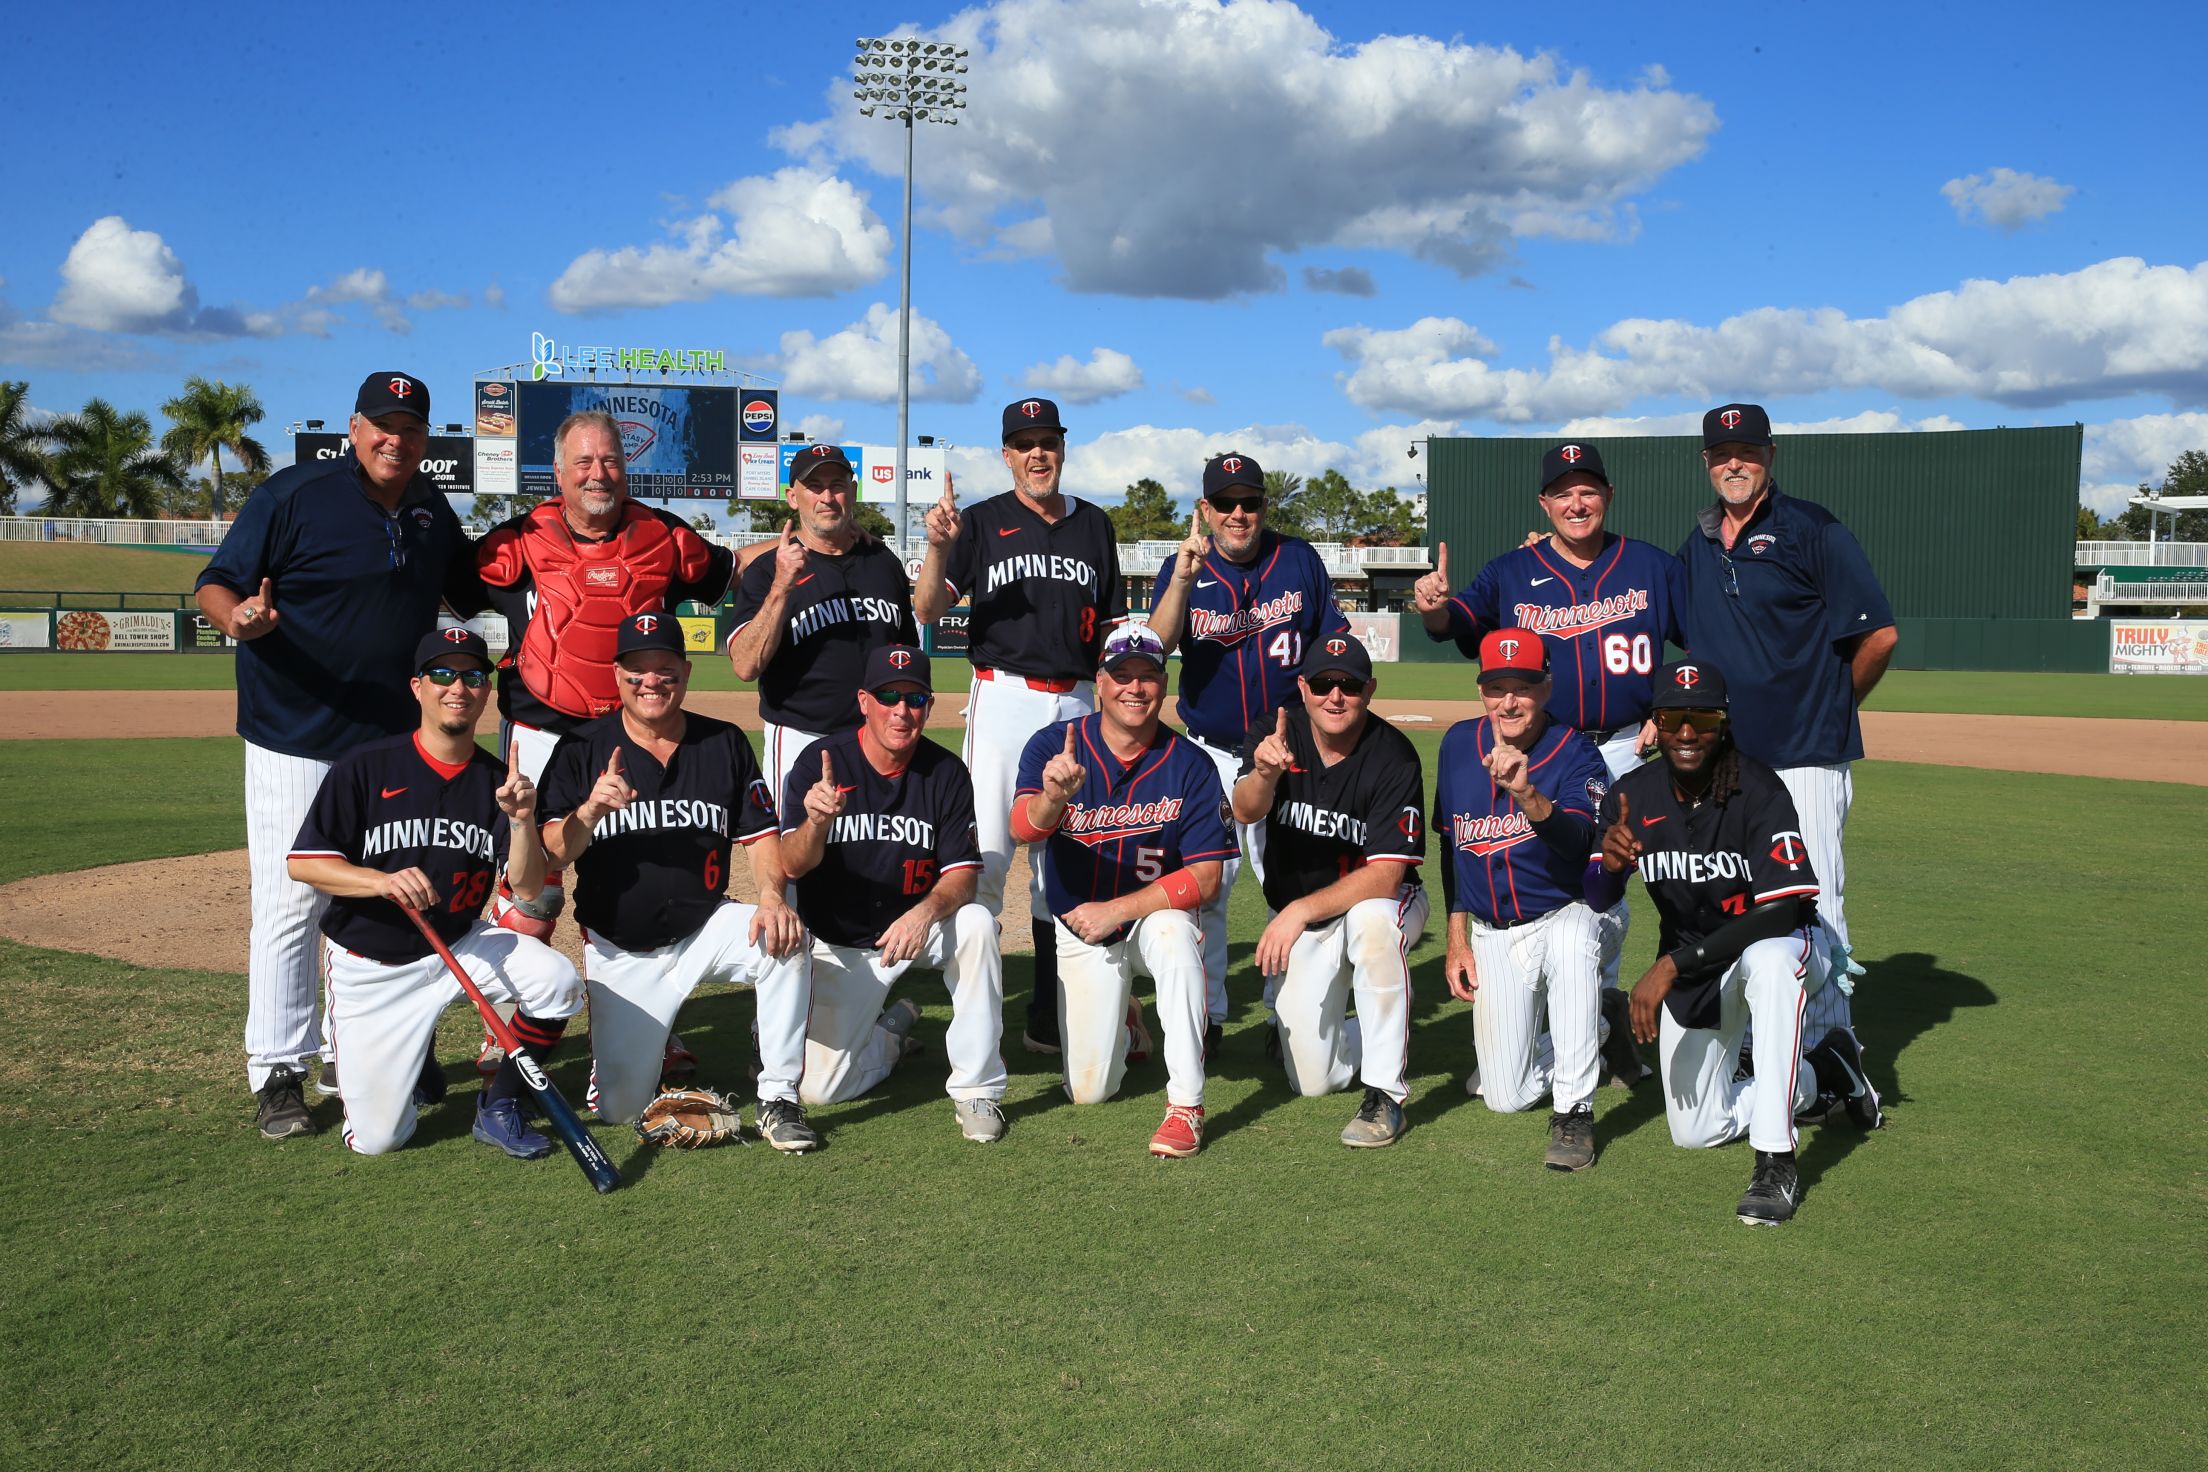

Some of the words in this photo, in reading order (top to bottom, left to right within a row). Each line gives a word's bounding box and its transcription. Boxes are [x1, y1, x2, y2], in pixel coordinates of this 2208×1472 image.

[562, 345, 612, 368] LEE
[619, 348, 724, 371] HEALTH
[691, 473, 712, 482] 2:53
[715, 474, 731, 482] PM
[906, 467, 932, 480] ank
[910, 564, 922, 576] 14
[119, 615, 166, 630] GRIMALDI'S
[791, 597, 902, 646] MINNESOT
[1190, 591, 1302, 639] Minnesota
[1514, 588, 1648, 635] Minnesota
[1603, 632, 1652, 676] 60
[2115, 628, 2169, 645] TRULY
[2115, 644, 2168, 656] MIGHTY
[363, 818, 495, 863] MINNESOTA
[826, 813, 936, 850] INNESOT
[704, 849, 720, 891] 6
[902, 858, 936, 895] 15
[1136, 847, 1164, 882] 5
[449, 870, 489, 912] 28
